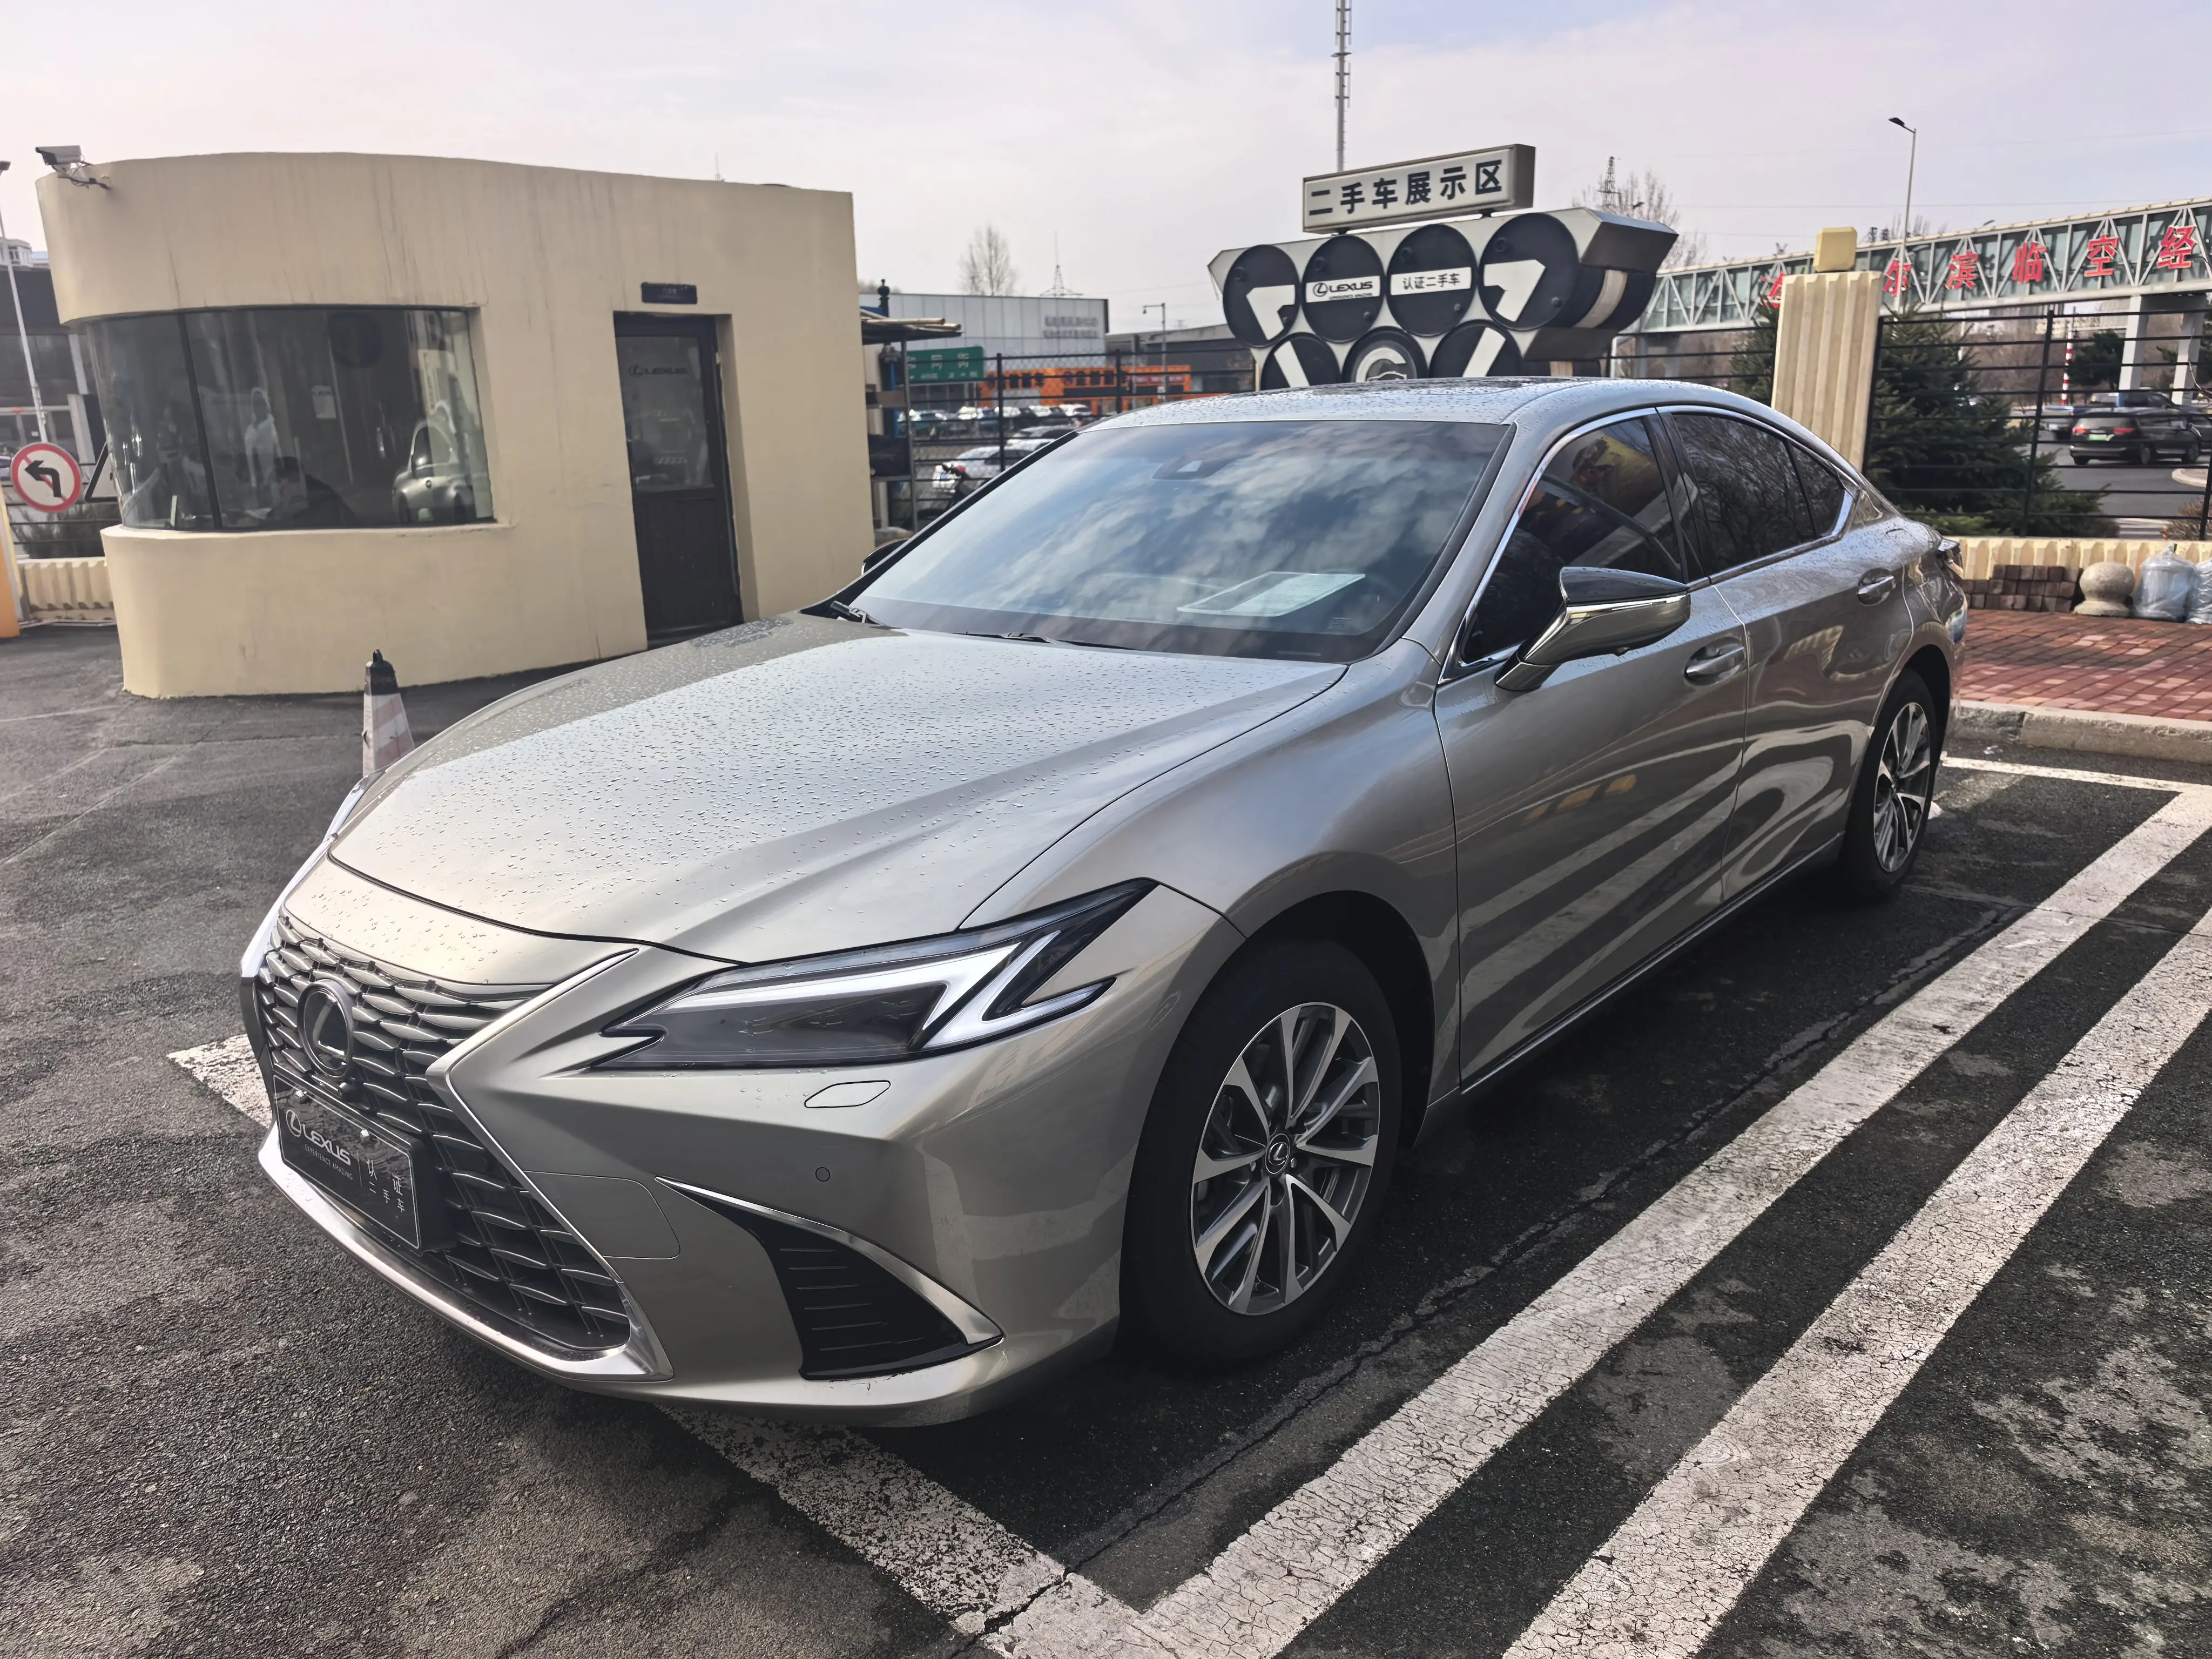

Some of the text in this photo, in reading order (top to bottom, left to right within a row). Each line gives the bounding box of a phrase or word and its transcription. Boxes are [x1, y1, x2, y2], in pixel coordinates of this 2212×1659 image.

[1309, 159, 1502, 216] 二手车展示区
[1329, 281, 1373, 293] LEXUS
[1402, 273, 1460, 290] 认证二手车
[302, 1123, 351, 1166] LEXUS
[305, 1144, 353, 1181] EXPERIENCE AMAZING
[366, 1158, 403, 1196] 认证
[369, 1181, 406, 1212] 二手车
